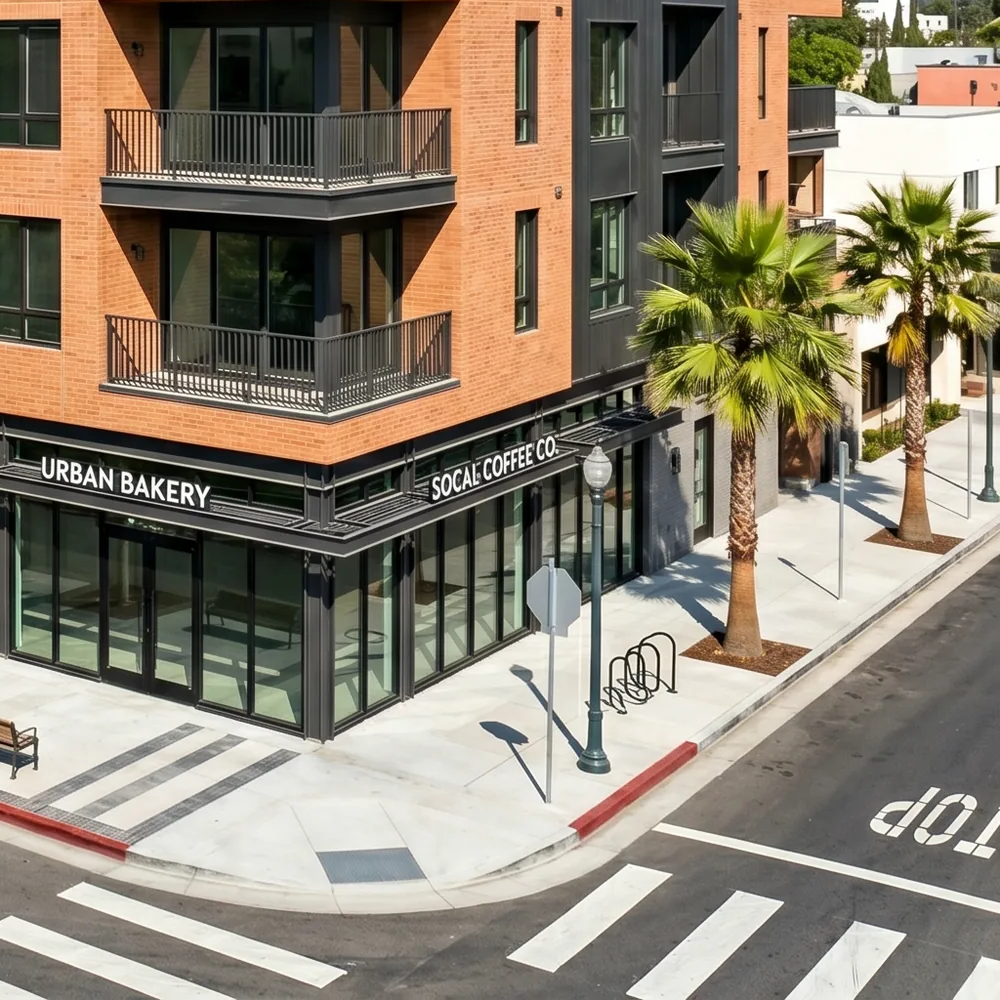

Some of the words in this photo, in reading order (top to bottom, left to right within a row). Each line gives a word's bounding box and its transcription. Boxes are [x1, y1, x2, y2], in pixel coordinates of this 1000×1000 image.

[41, 456, 114, 492] URBAN
[120, 471, 211, 509] BAKERY
[432, 463, 480, 501] SOCAL
[483, 442, 533, 481] COFFEE
[536, 435, 560, 461] CO.
[870, 786, 1000, 860] TOP
